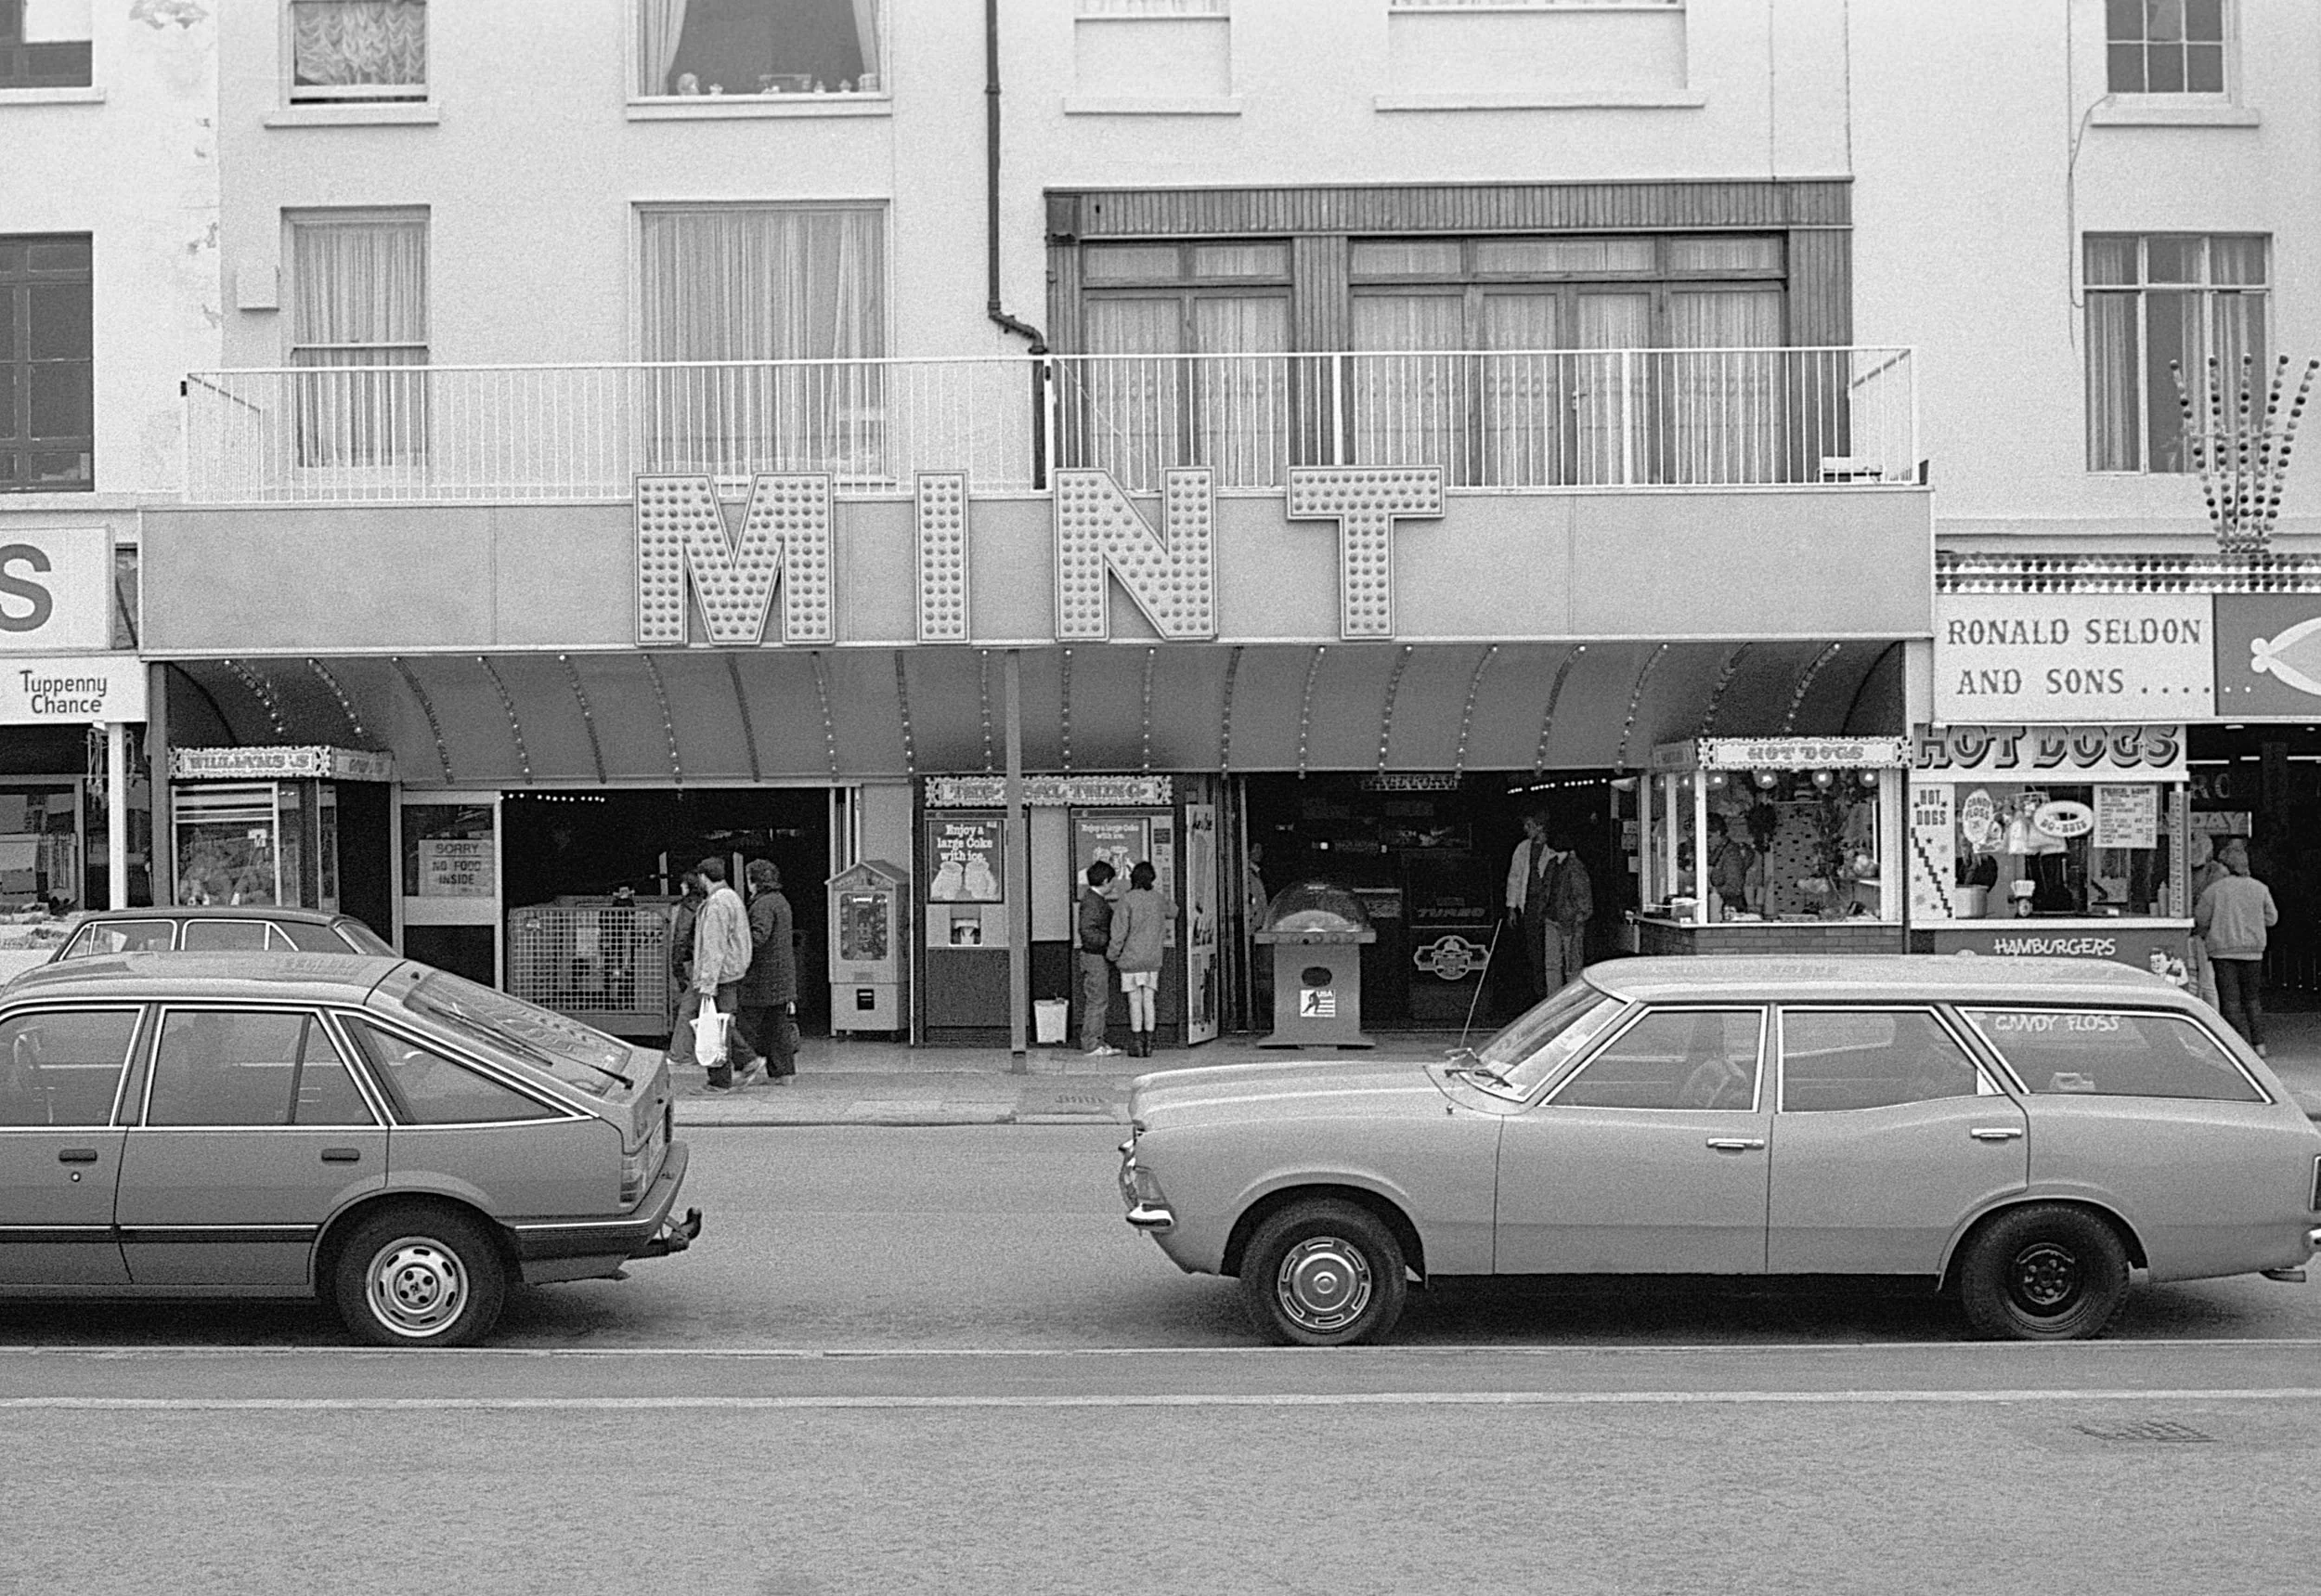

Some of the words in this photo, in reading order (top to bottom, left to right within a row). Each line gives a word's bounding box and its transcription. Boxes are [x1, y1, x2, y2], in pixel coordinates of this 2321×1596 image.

[631, 465, 1446, 646] MINT
[0, 543, 54, 632] S
[1948, 618, 2069, 644] RONALD
[2085, 617, 2202, 644] SELDON
[19, 669, 108, 697] Tuppenny
[1956, 668, 2022, 694] AND
[2045, 668, 2124, 694] SONS
[31, 694, 102, 714] Chance
[1746, 746, 1796, 760] HOT
[1798, 746, 1865, 760] DOGS
[1913, 722, 2027, 770] HOT
[2030, 723, 2180, 770] DOGS
[1919, 789, 1941, 805] HOT
[1967, 797, 1992, 810] CANDY
[1915, 810, 1947, 825] DOGS
[1964, 807, 1990, 821] FLOSS
[945, 824, 977, 837] Enjoy
[978, 826, 984, 835] a
[435, 843, 480, 854] SORRY
[937, 837, 965, 850] large
[966, 837, 993, 849] Coke
[940, 850, 966, 862] with
[967, 850, 987, 862] ice.
[432, 861, 447, 872] NO
[453, 861, 482, 872] FOOD
[438, 874, 475, 885] INSIDE
[1993, 938, 2117, 956] HAMBURGERS
[1316, 990, 1333, 998] USA
[1994, 1015, 2058, 1032] CANDY
[2068, 1015, 2121, 1032] FLOSS
